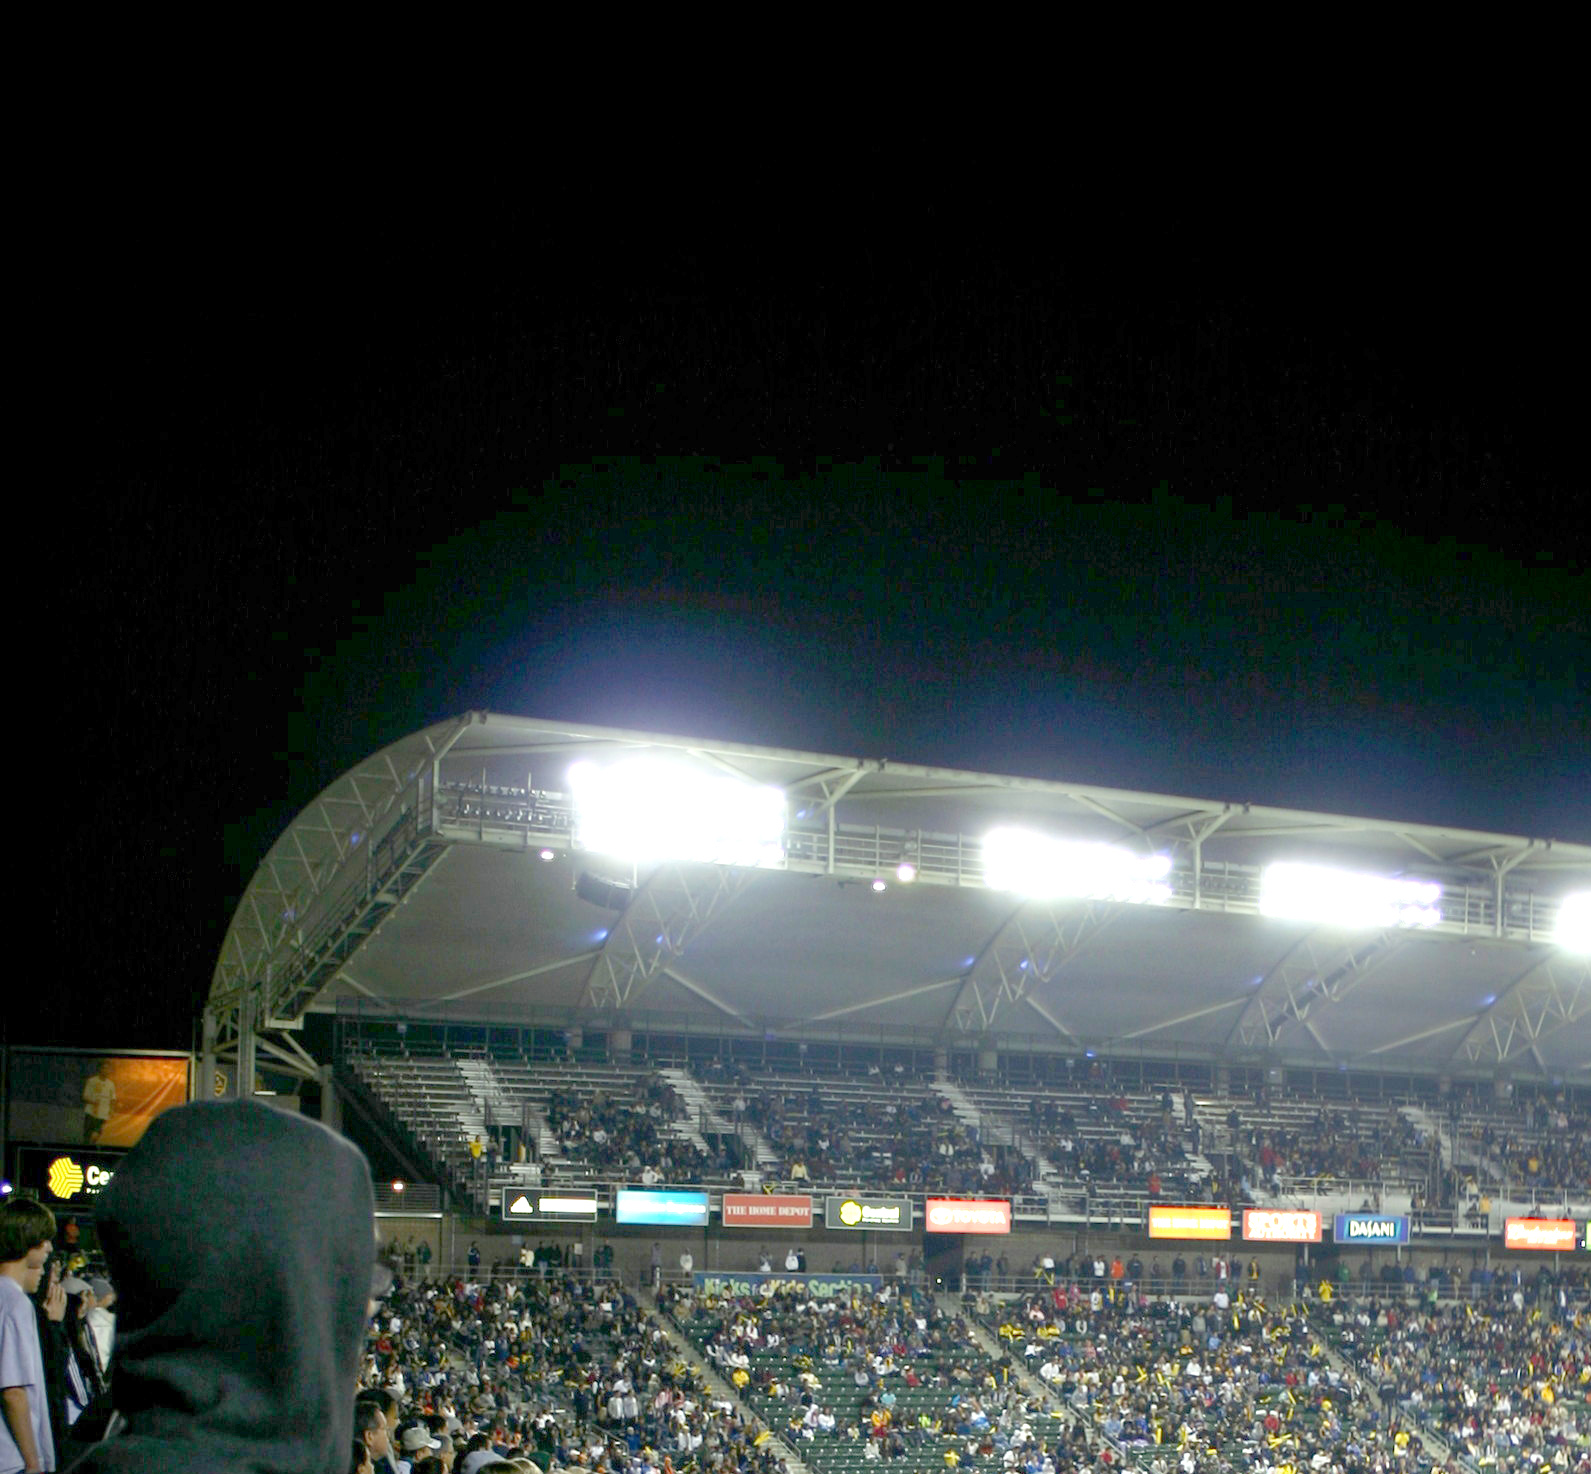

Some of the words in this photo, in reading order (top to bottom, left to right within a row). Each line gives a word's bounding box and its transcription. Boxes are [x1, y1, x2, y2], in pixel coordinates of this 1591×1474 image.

[726, 1205, 747, 1215] THE
[749, 1205, 777, 1216] HOME
[778, 1206, 811, 1217] DEPOT
[1349, 1219, 1396, 1238] DASANI
